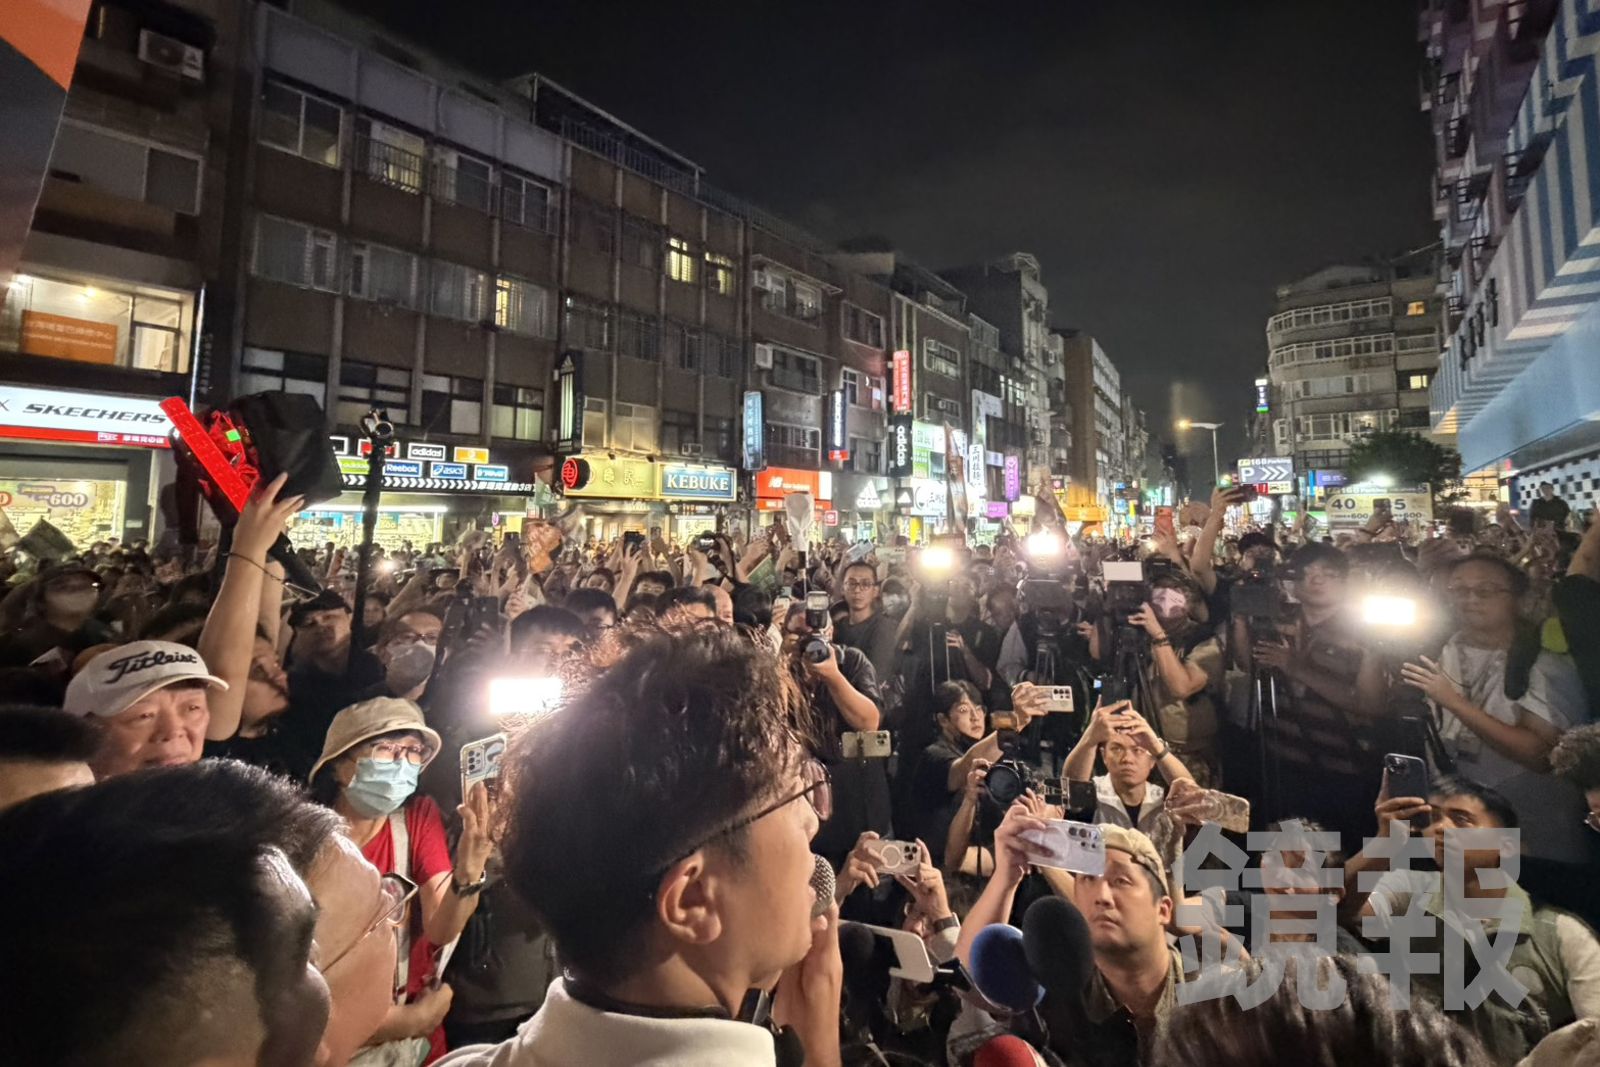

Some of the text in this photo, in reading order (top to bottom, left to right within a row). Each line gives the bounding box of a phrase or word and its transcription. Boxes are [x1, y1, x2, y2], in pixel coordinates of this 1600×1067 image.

[22, 403, 167, 424] SKECHERS
[411, 447, 442, 458] adidas
[897, 425, 908, 467] adidas
[386, 464, 418, 474] Reebok
[442, 464, 464, 475] asics
[1240, 467, 1255, 483] P
[667, 473, 730, 491] KEBUKE
[49, 492, 87, 507] 600
[1331, 498, 1357, 510] 40
[104, 651, 197, 684] Titleist
